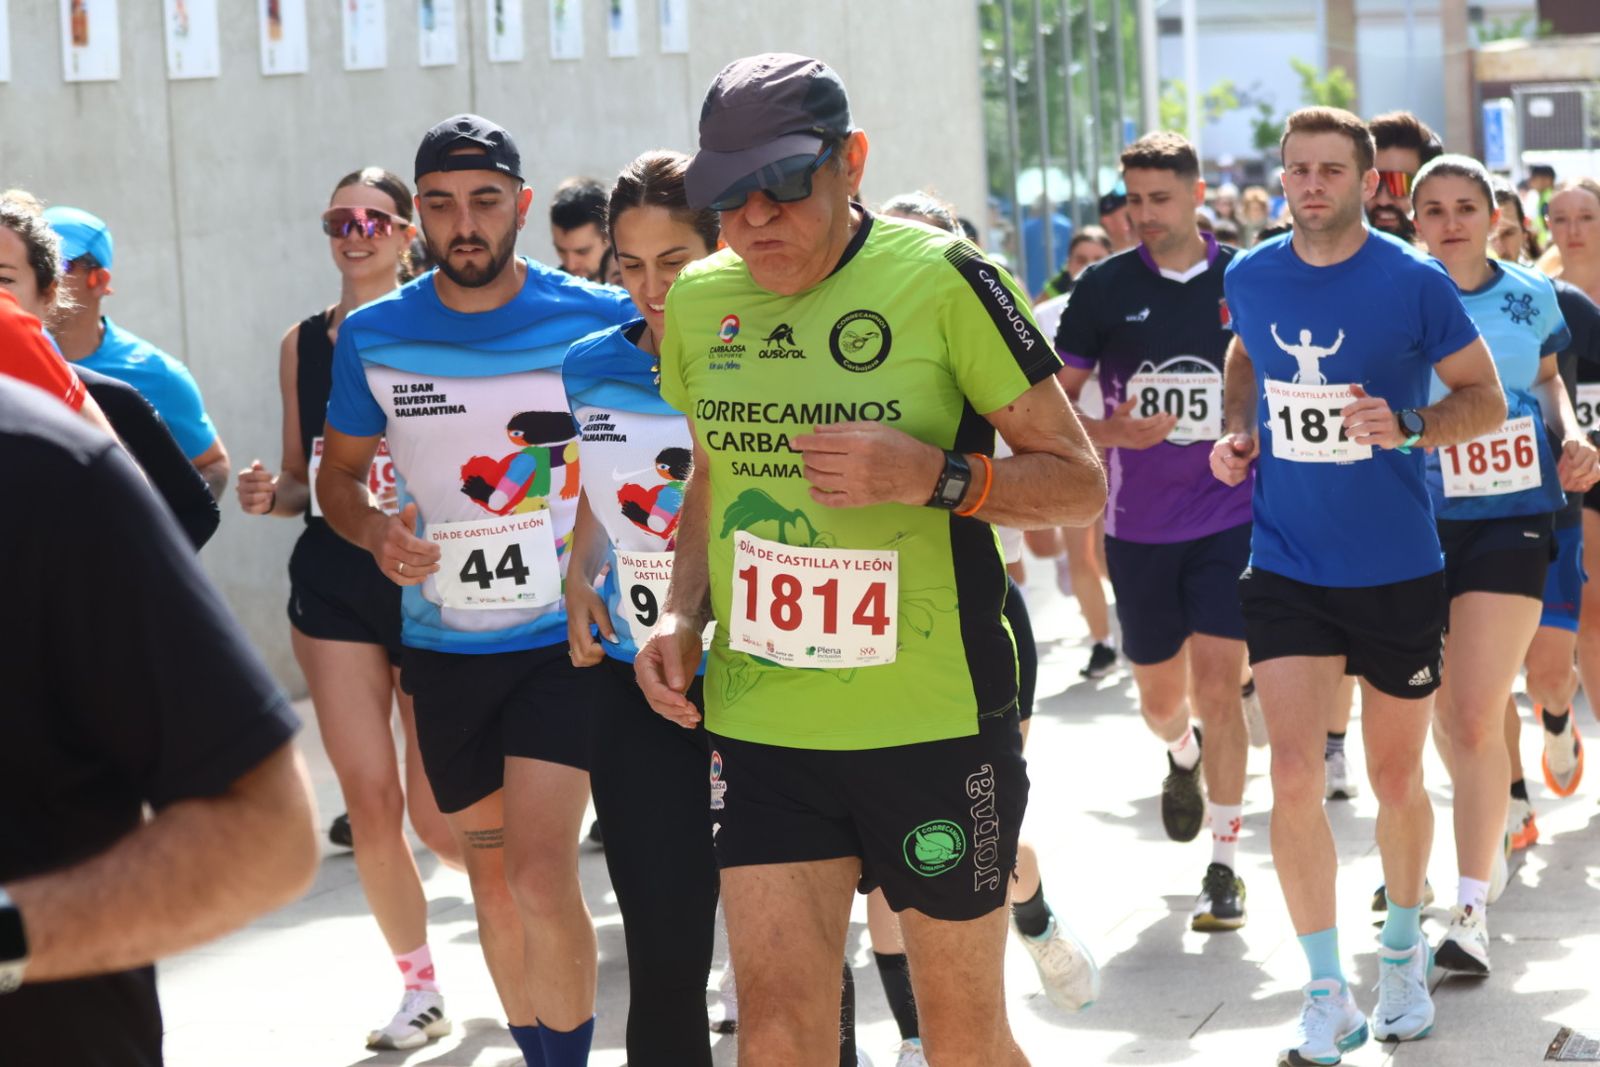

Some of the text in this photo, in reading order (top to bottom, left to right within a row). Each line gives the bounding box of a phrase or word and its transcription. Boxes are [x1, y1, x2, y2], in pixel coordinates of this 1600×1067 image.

[836, 312, 887, 329] CORRECAMINOS
[978, 270, 1035, 351] CARBAJOSA
[411, 383, 433, 393] SAN
[393, 394, 447, 406] SILVESTRE
[395, 405, 467, 417] SALMANTINA
[697, 399, 901, 424] CORRECAMINOS
[1140, 387, 1207, 422] 805
[1444, 435, 1534, 475] 1856
[433, 531, 448, 540] DÍA
[450, 531, 463, 539] DE
[464, 526, 508, 538] CASTILLA
[518, 519, 544, 530] LEÓN
[460, 543, 529, 589] 44
[636, 560, 648, 568] DE
[650, 560, 663, 568] LA
[740, 541, 892, 571] DÍA DE CASTILLA Y LEÓN
[739, 565, 890, 635] 1814
[817, 646, 842, 655] Plena
